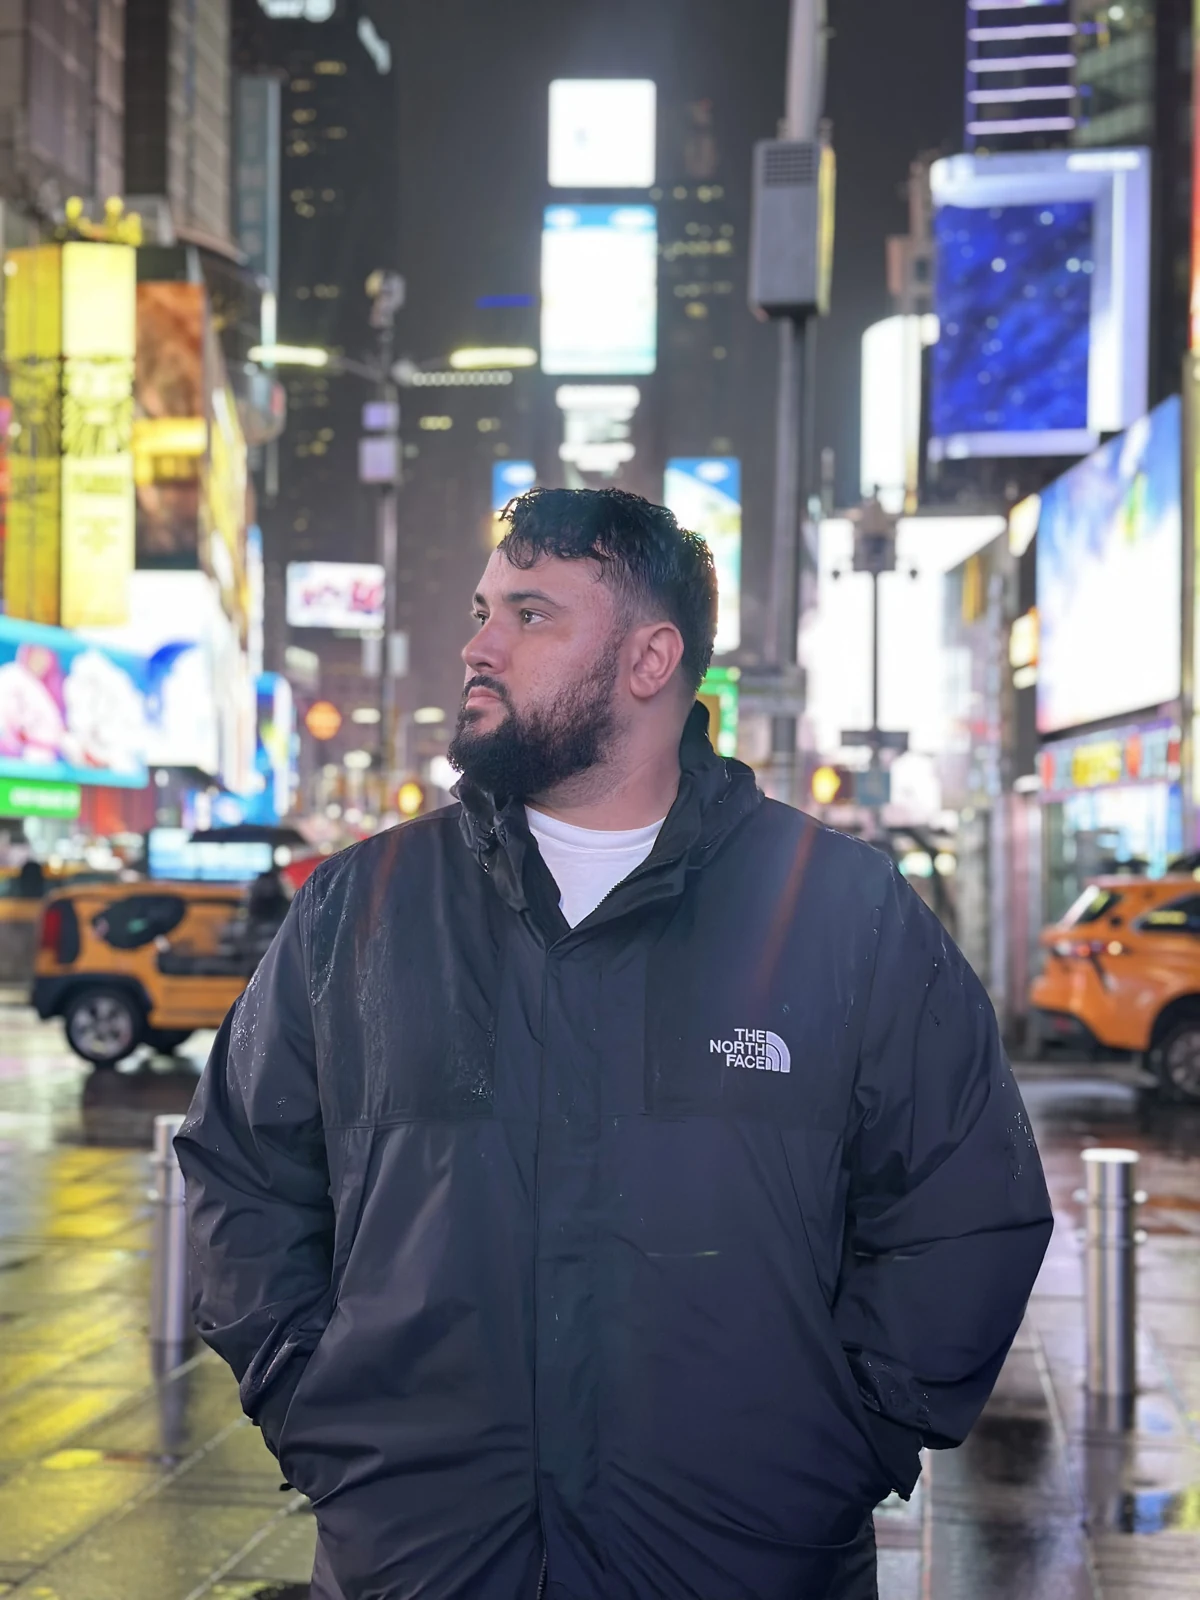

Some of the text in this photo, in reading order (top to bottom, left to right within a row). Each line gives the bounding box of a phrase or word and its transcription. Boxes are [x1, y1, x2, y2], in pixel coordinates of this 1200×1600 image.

[733, 1028, 766, 1043] THE
[709, 1039, 765, 1056] NORTH
[726, 1054, 766, 1070] FACE
